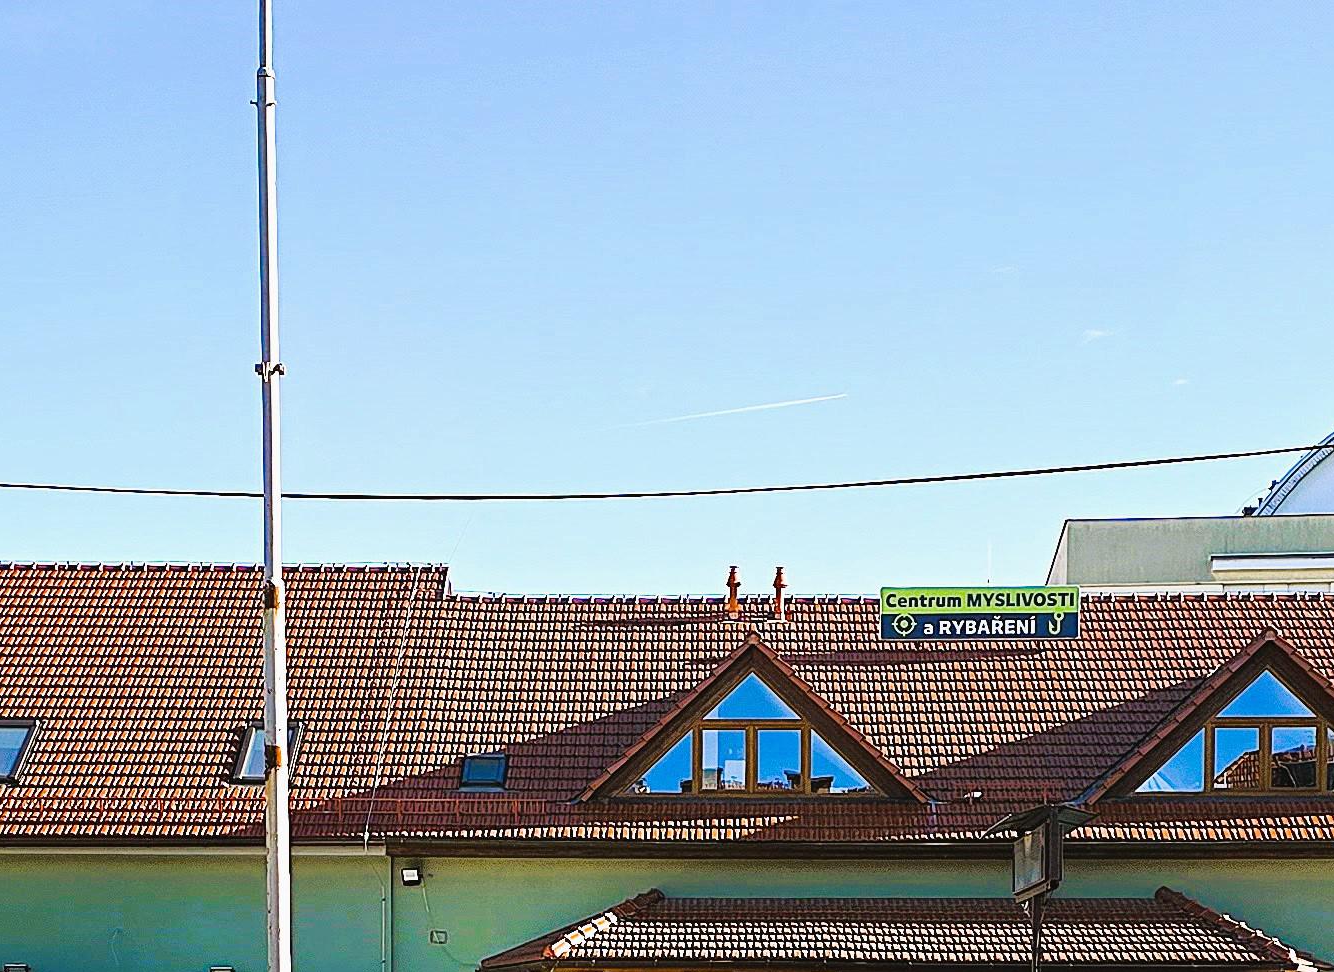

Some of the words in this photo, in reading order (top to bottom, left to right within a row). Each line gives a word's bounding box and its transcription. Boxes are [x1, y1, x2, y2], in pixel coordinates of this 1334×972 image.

[885, 592, 962, 608] Centrum
[966, 592, 1075, 608] MYSLIVOSTI
[923, 622, 934, 635] a
[938, 615, 1037, 635] RYBAŘENÍ
